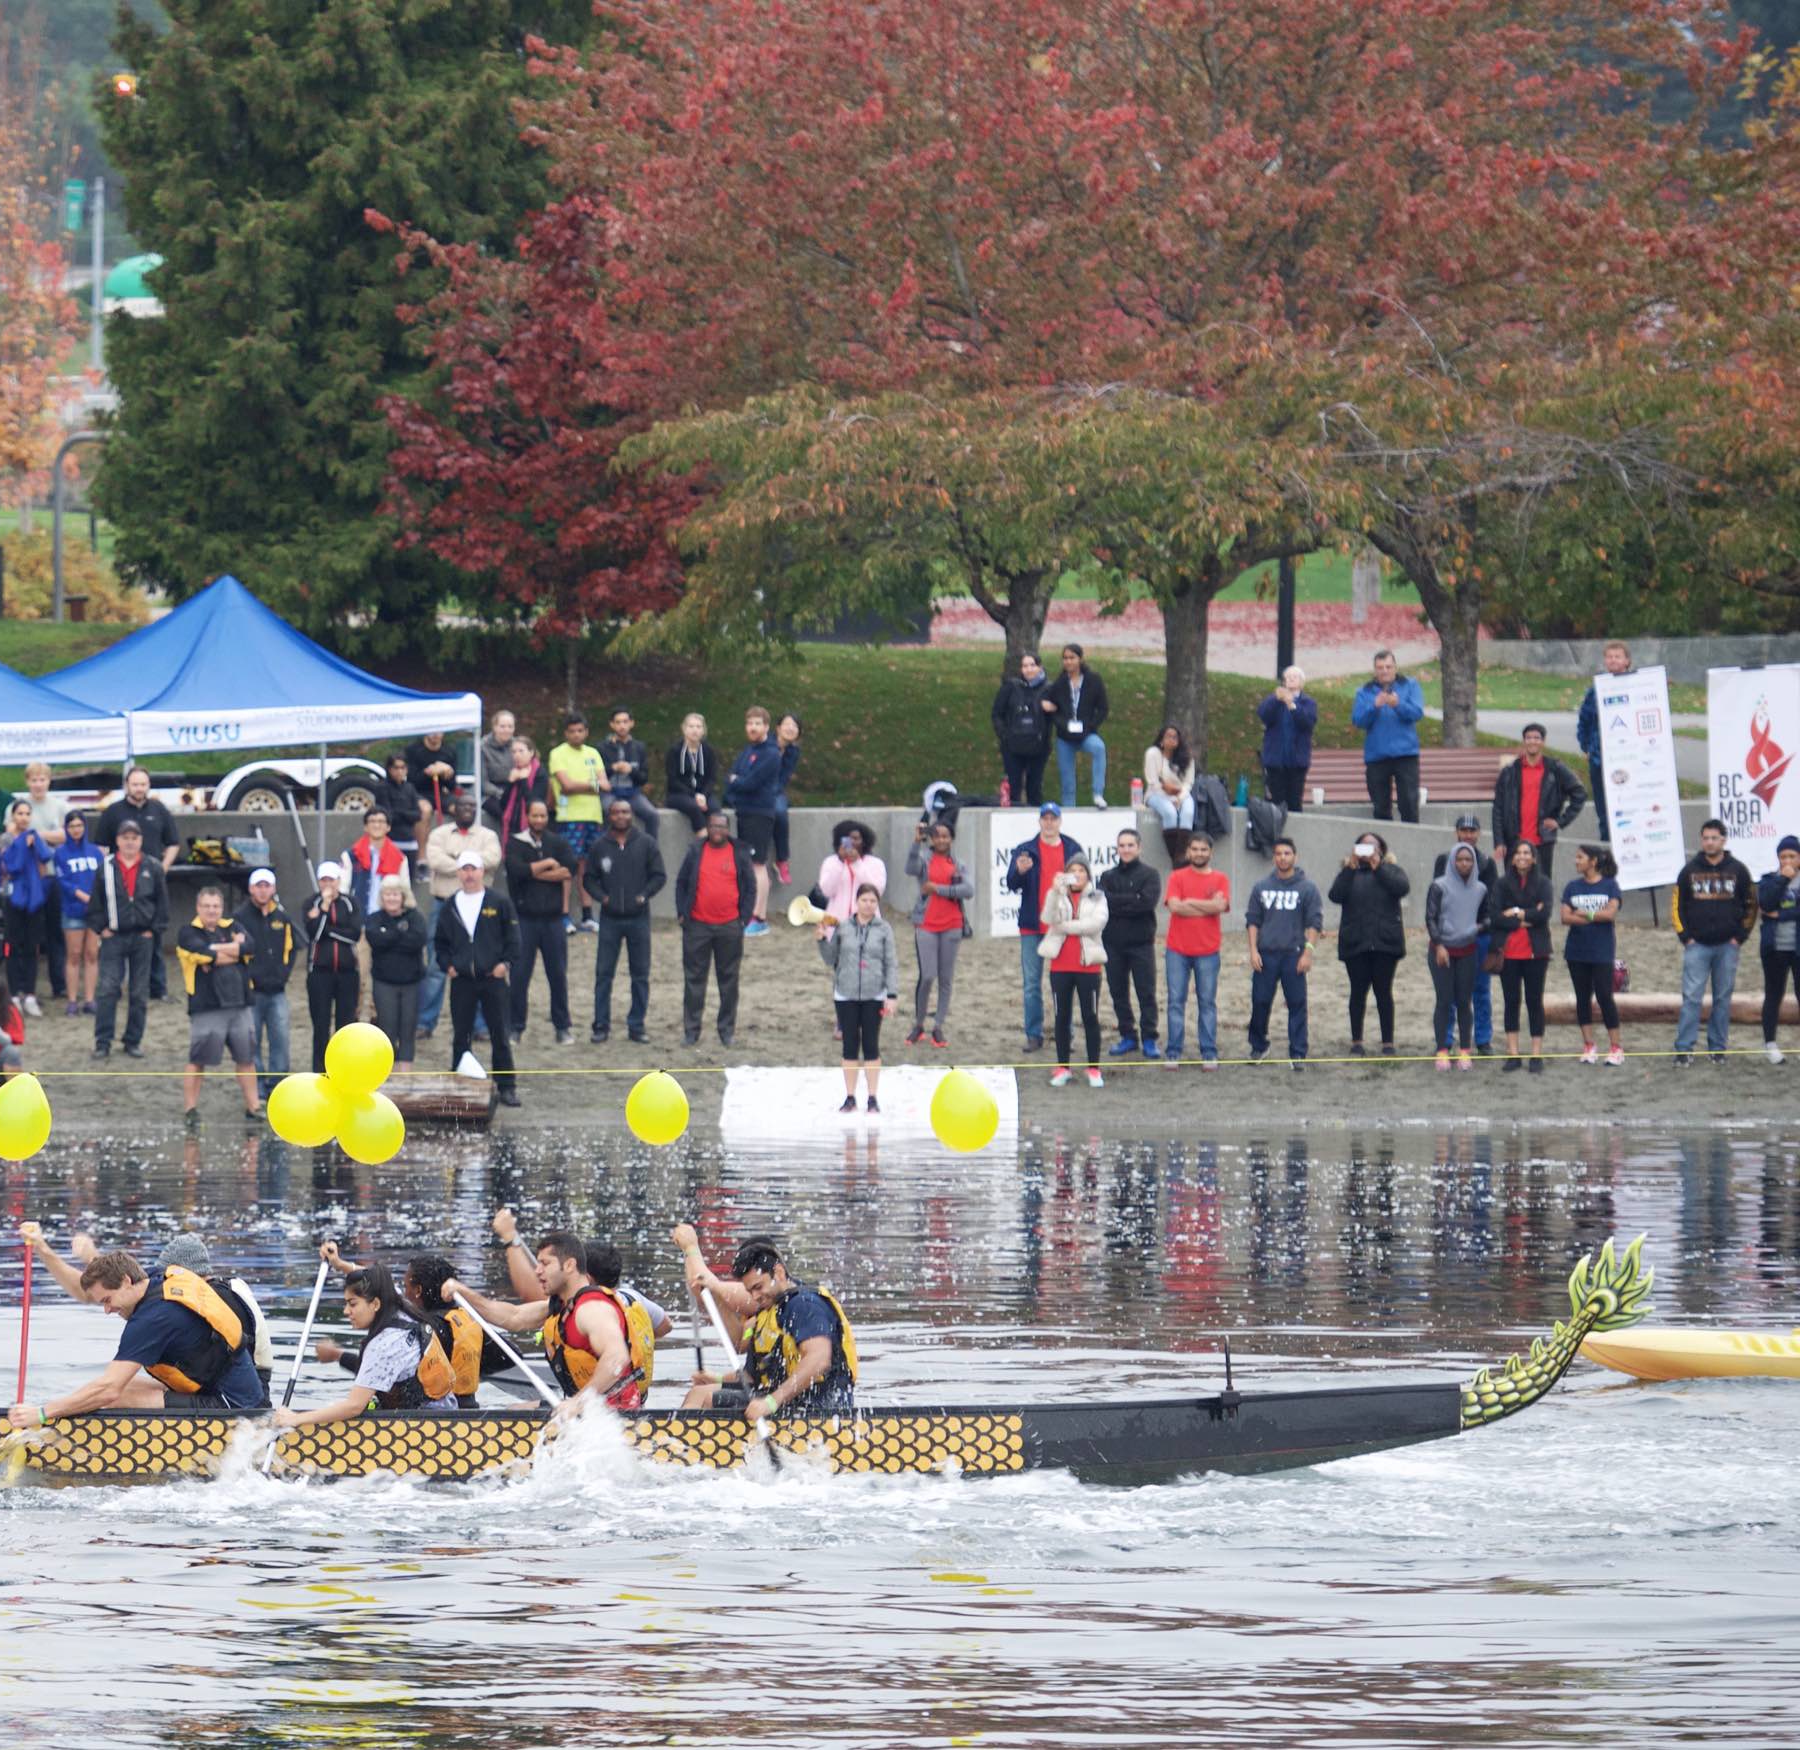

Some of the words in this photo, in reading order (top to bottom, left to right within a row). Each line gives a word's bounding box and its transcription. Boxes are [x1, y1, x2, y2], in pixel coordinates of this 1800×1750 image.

[168, 723, 241, 745] VIUSU
[1718, 773, 1742, 798] BC
[1719, 799, 1761, 825] MBA
[68, 857, 98, 873] TRU
[1261, 890, 1299, 910] VIU
